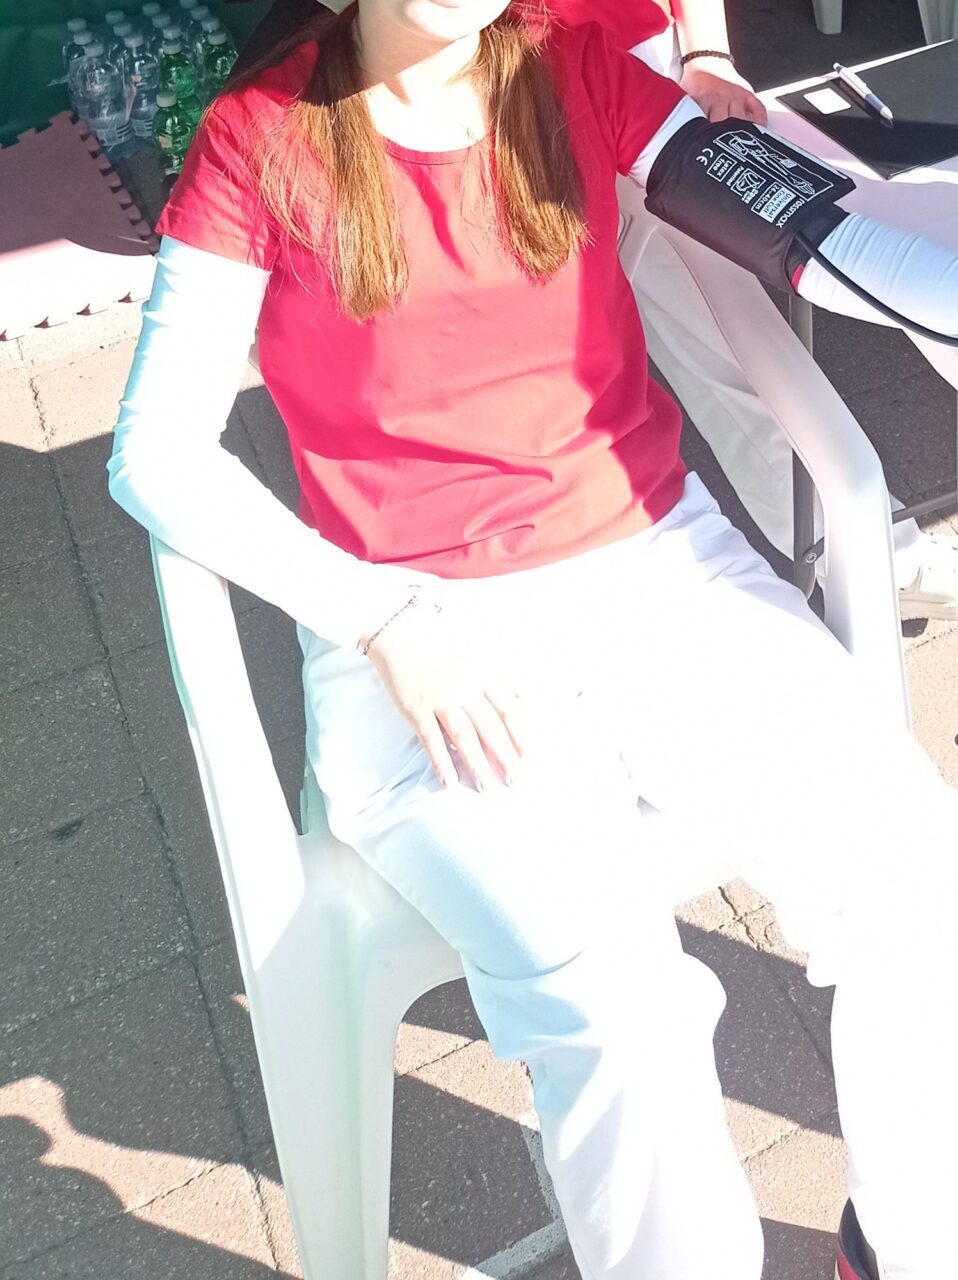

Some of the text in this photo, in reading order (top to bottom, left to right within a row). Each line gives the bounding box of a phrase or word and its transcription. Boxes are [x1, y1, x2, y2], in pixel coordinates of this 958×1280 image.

[712, 158, 725, 171] free
[716, 160, 733, 177] Latex
[766, 193, 793, 219] Universal
[775, 198, 806, 228] rossmax
